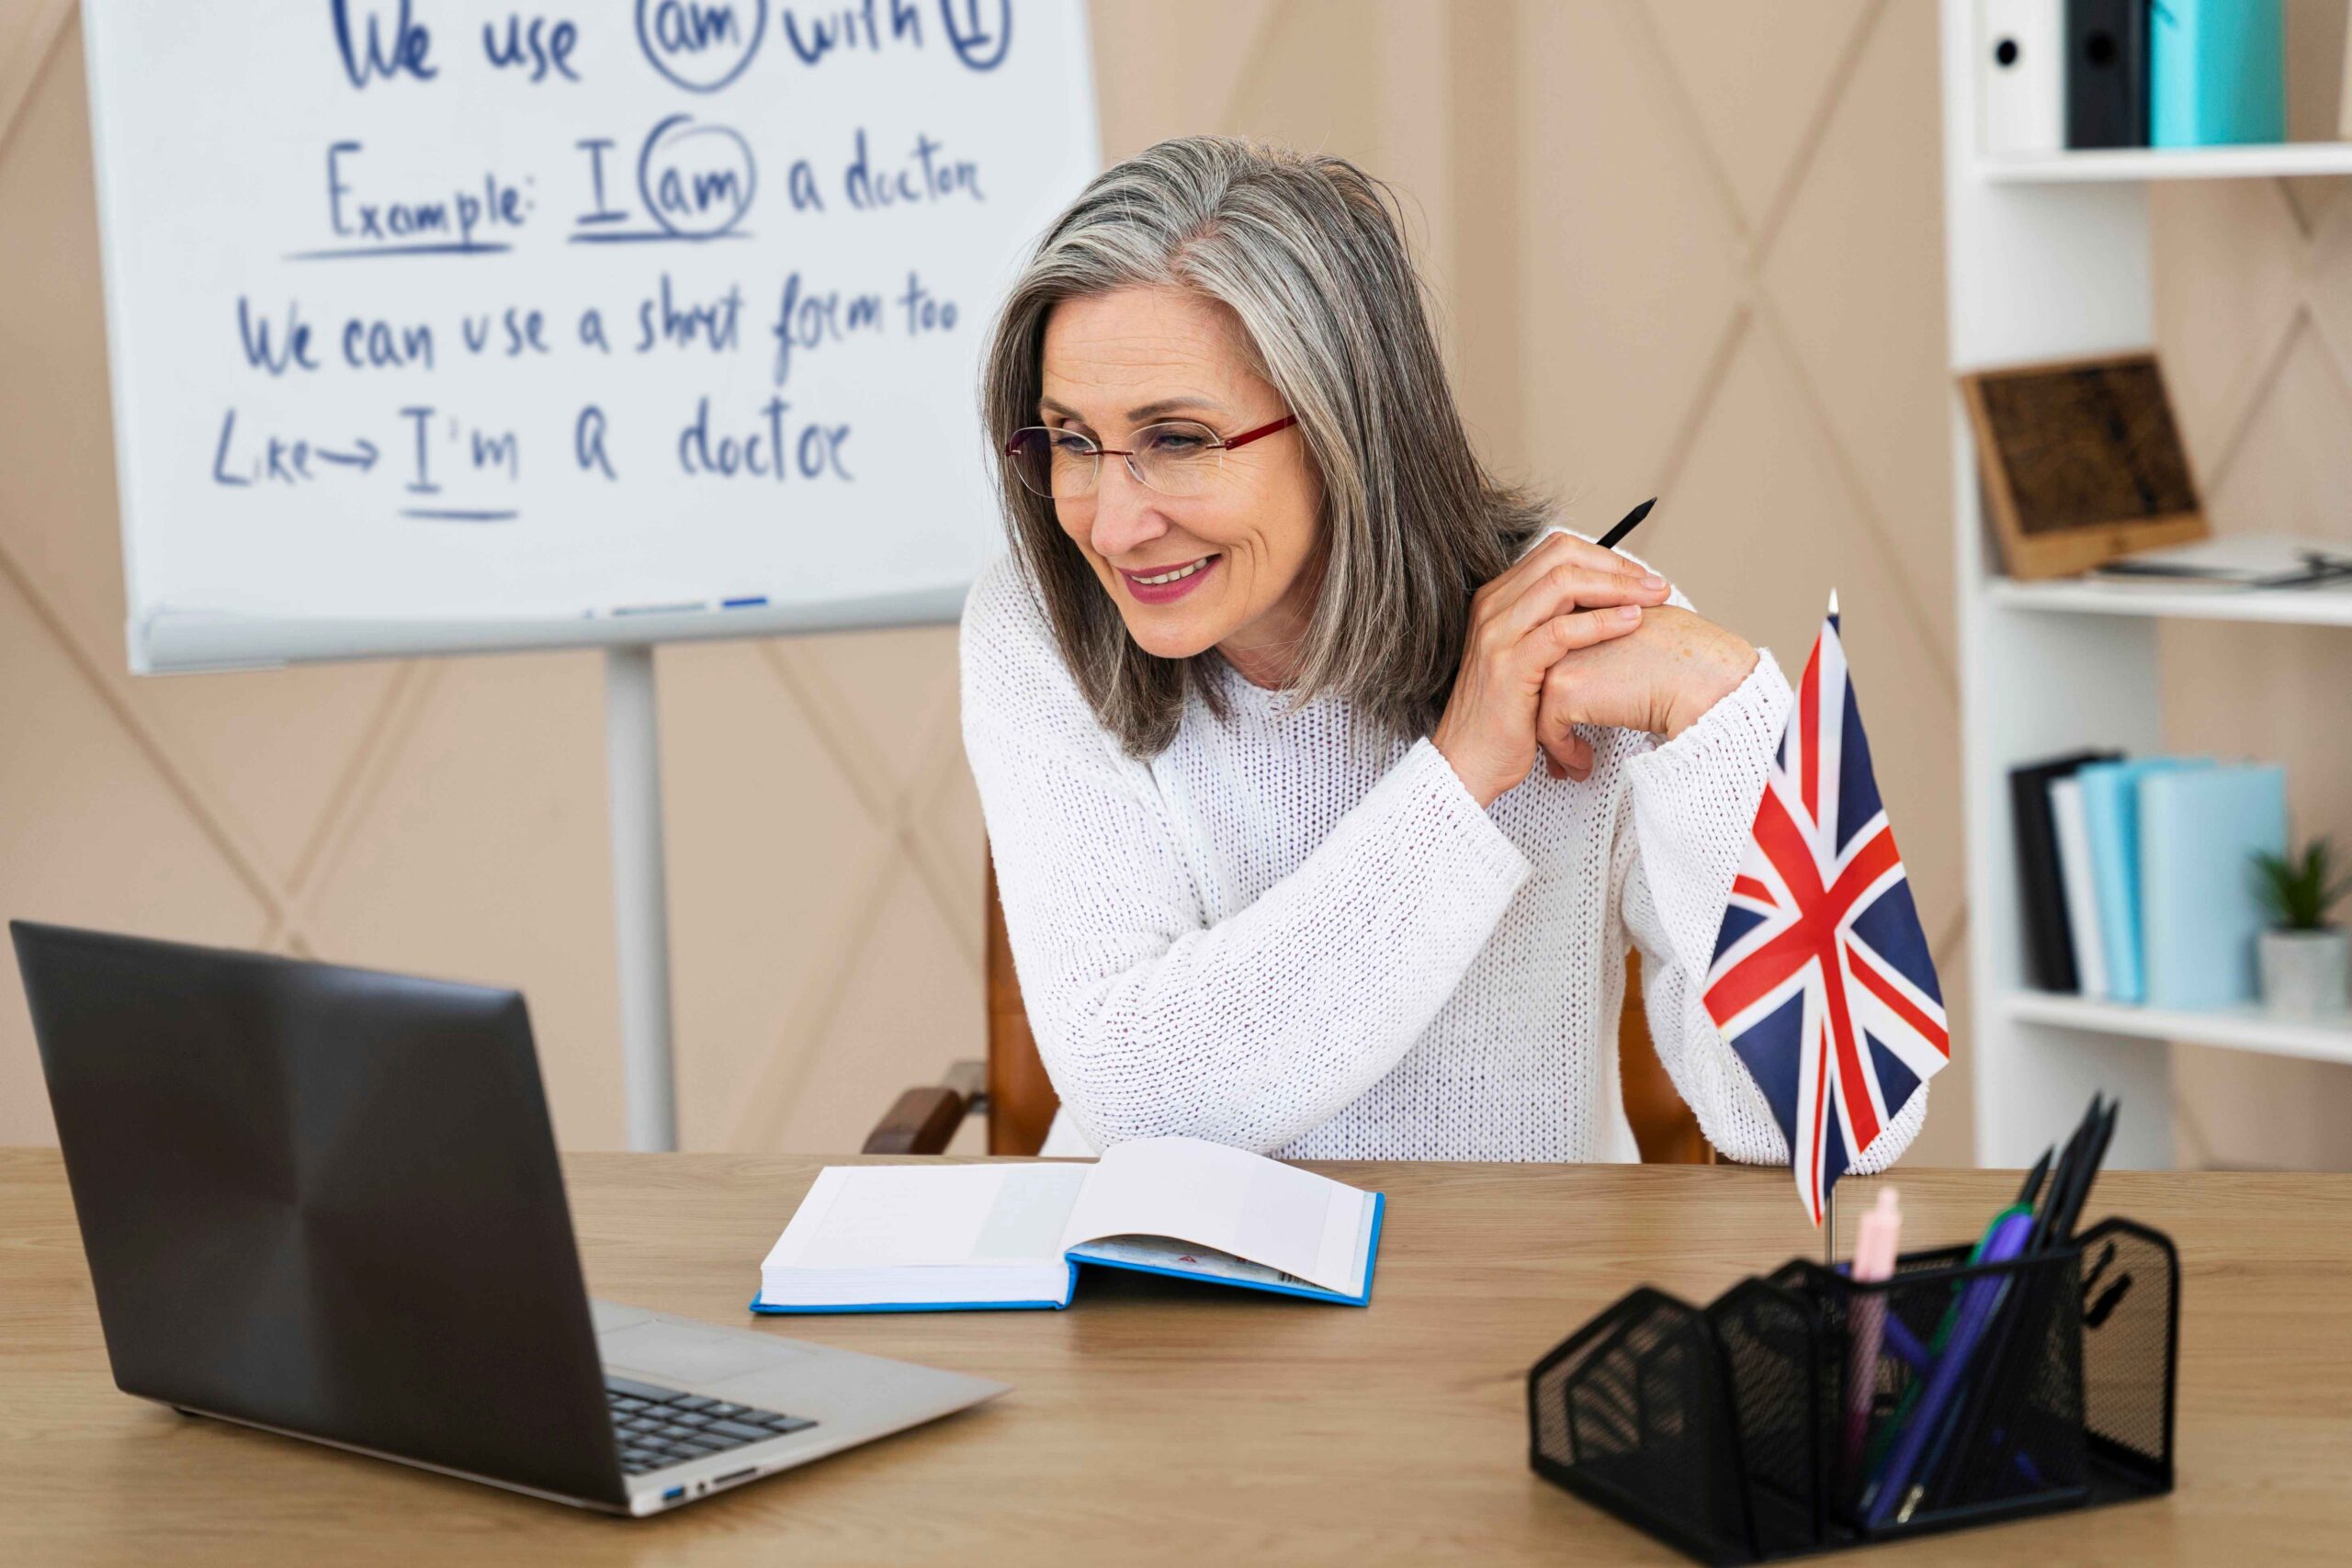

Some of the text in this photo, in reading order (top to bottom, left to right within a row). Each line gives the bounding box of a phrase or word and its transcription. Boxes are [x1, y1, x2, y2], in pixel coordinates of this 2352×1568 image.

[328, 0, 439, 90] We
[482, 14, 581, 84] use
[653, 0, 741, 55] am
[781, 0, 924, 67] with
[575, 138, 629, 226] I
[658, 165, 737, 216] am
[787, 159, 824, 212] a
[236, 272, 958, 387] We can use a short form too
[213, 407, 317, 486] Like
[399, 406, 518, 496] I'm
[677, 395, 854, 481] doctor
